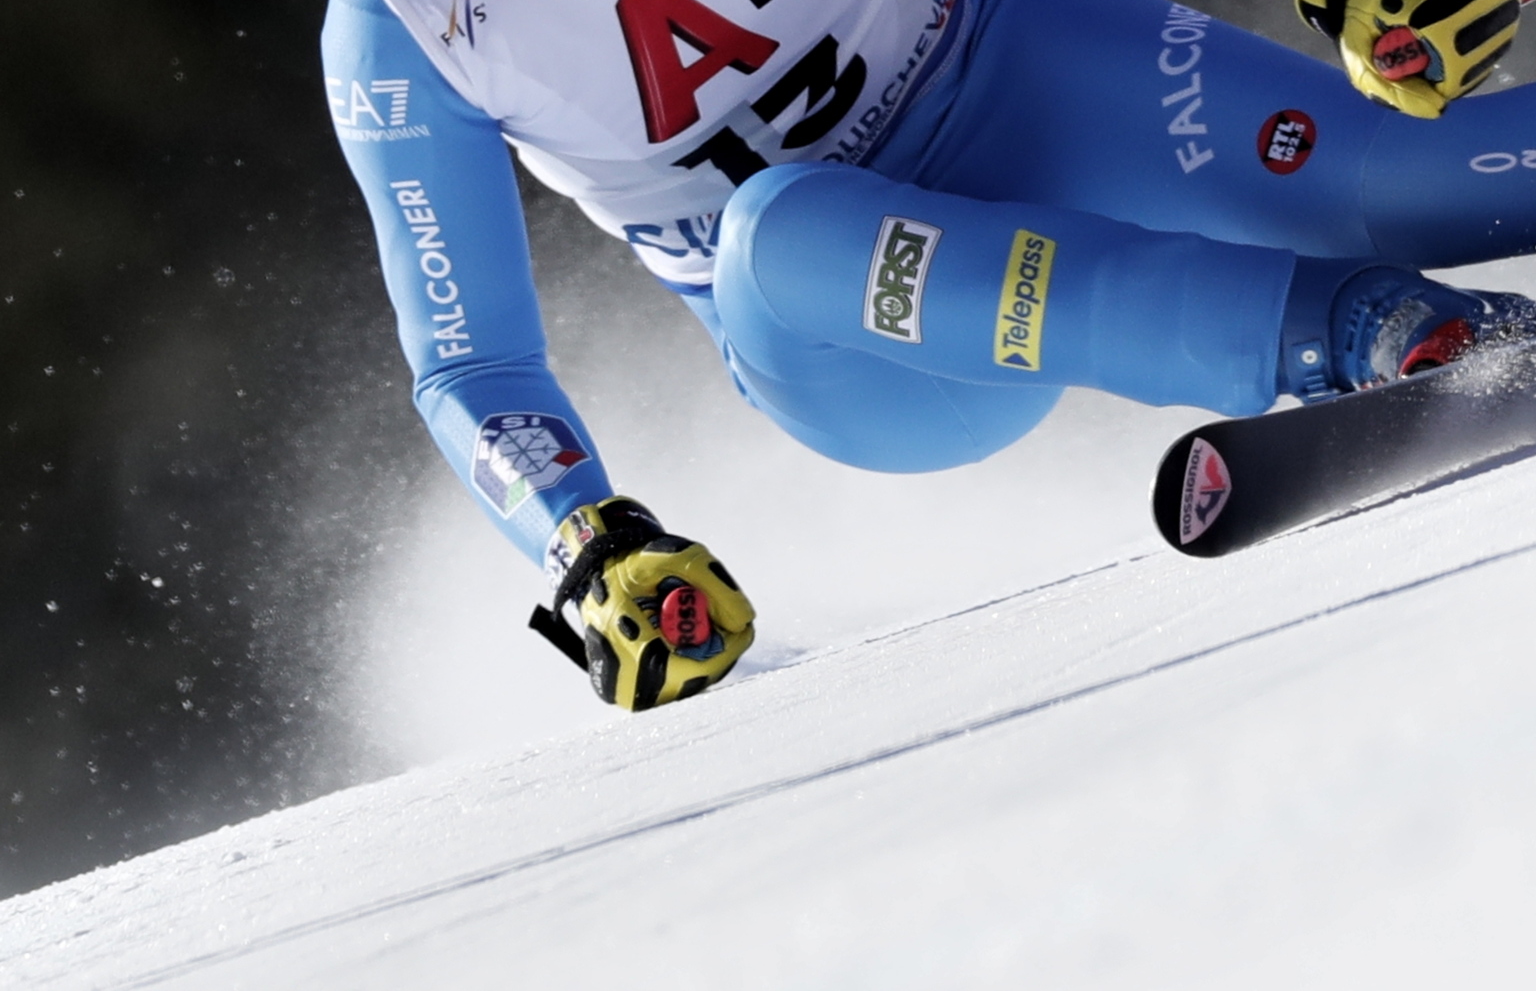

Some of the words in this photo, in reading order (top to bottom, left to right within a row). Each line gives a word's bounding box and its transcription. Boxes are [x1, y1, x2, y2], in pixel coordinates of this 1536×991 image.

[1268, 121, 1294, 160] RTL
[390, 179, 472, 359] FALCONERI
[873, 222, 928, 337] FORST
[1002, 236, 1045, 349] Telepass
[478, 416, 540, 460] FISI
[1182, 447, 1203, 537] ROSSIGNOL
